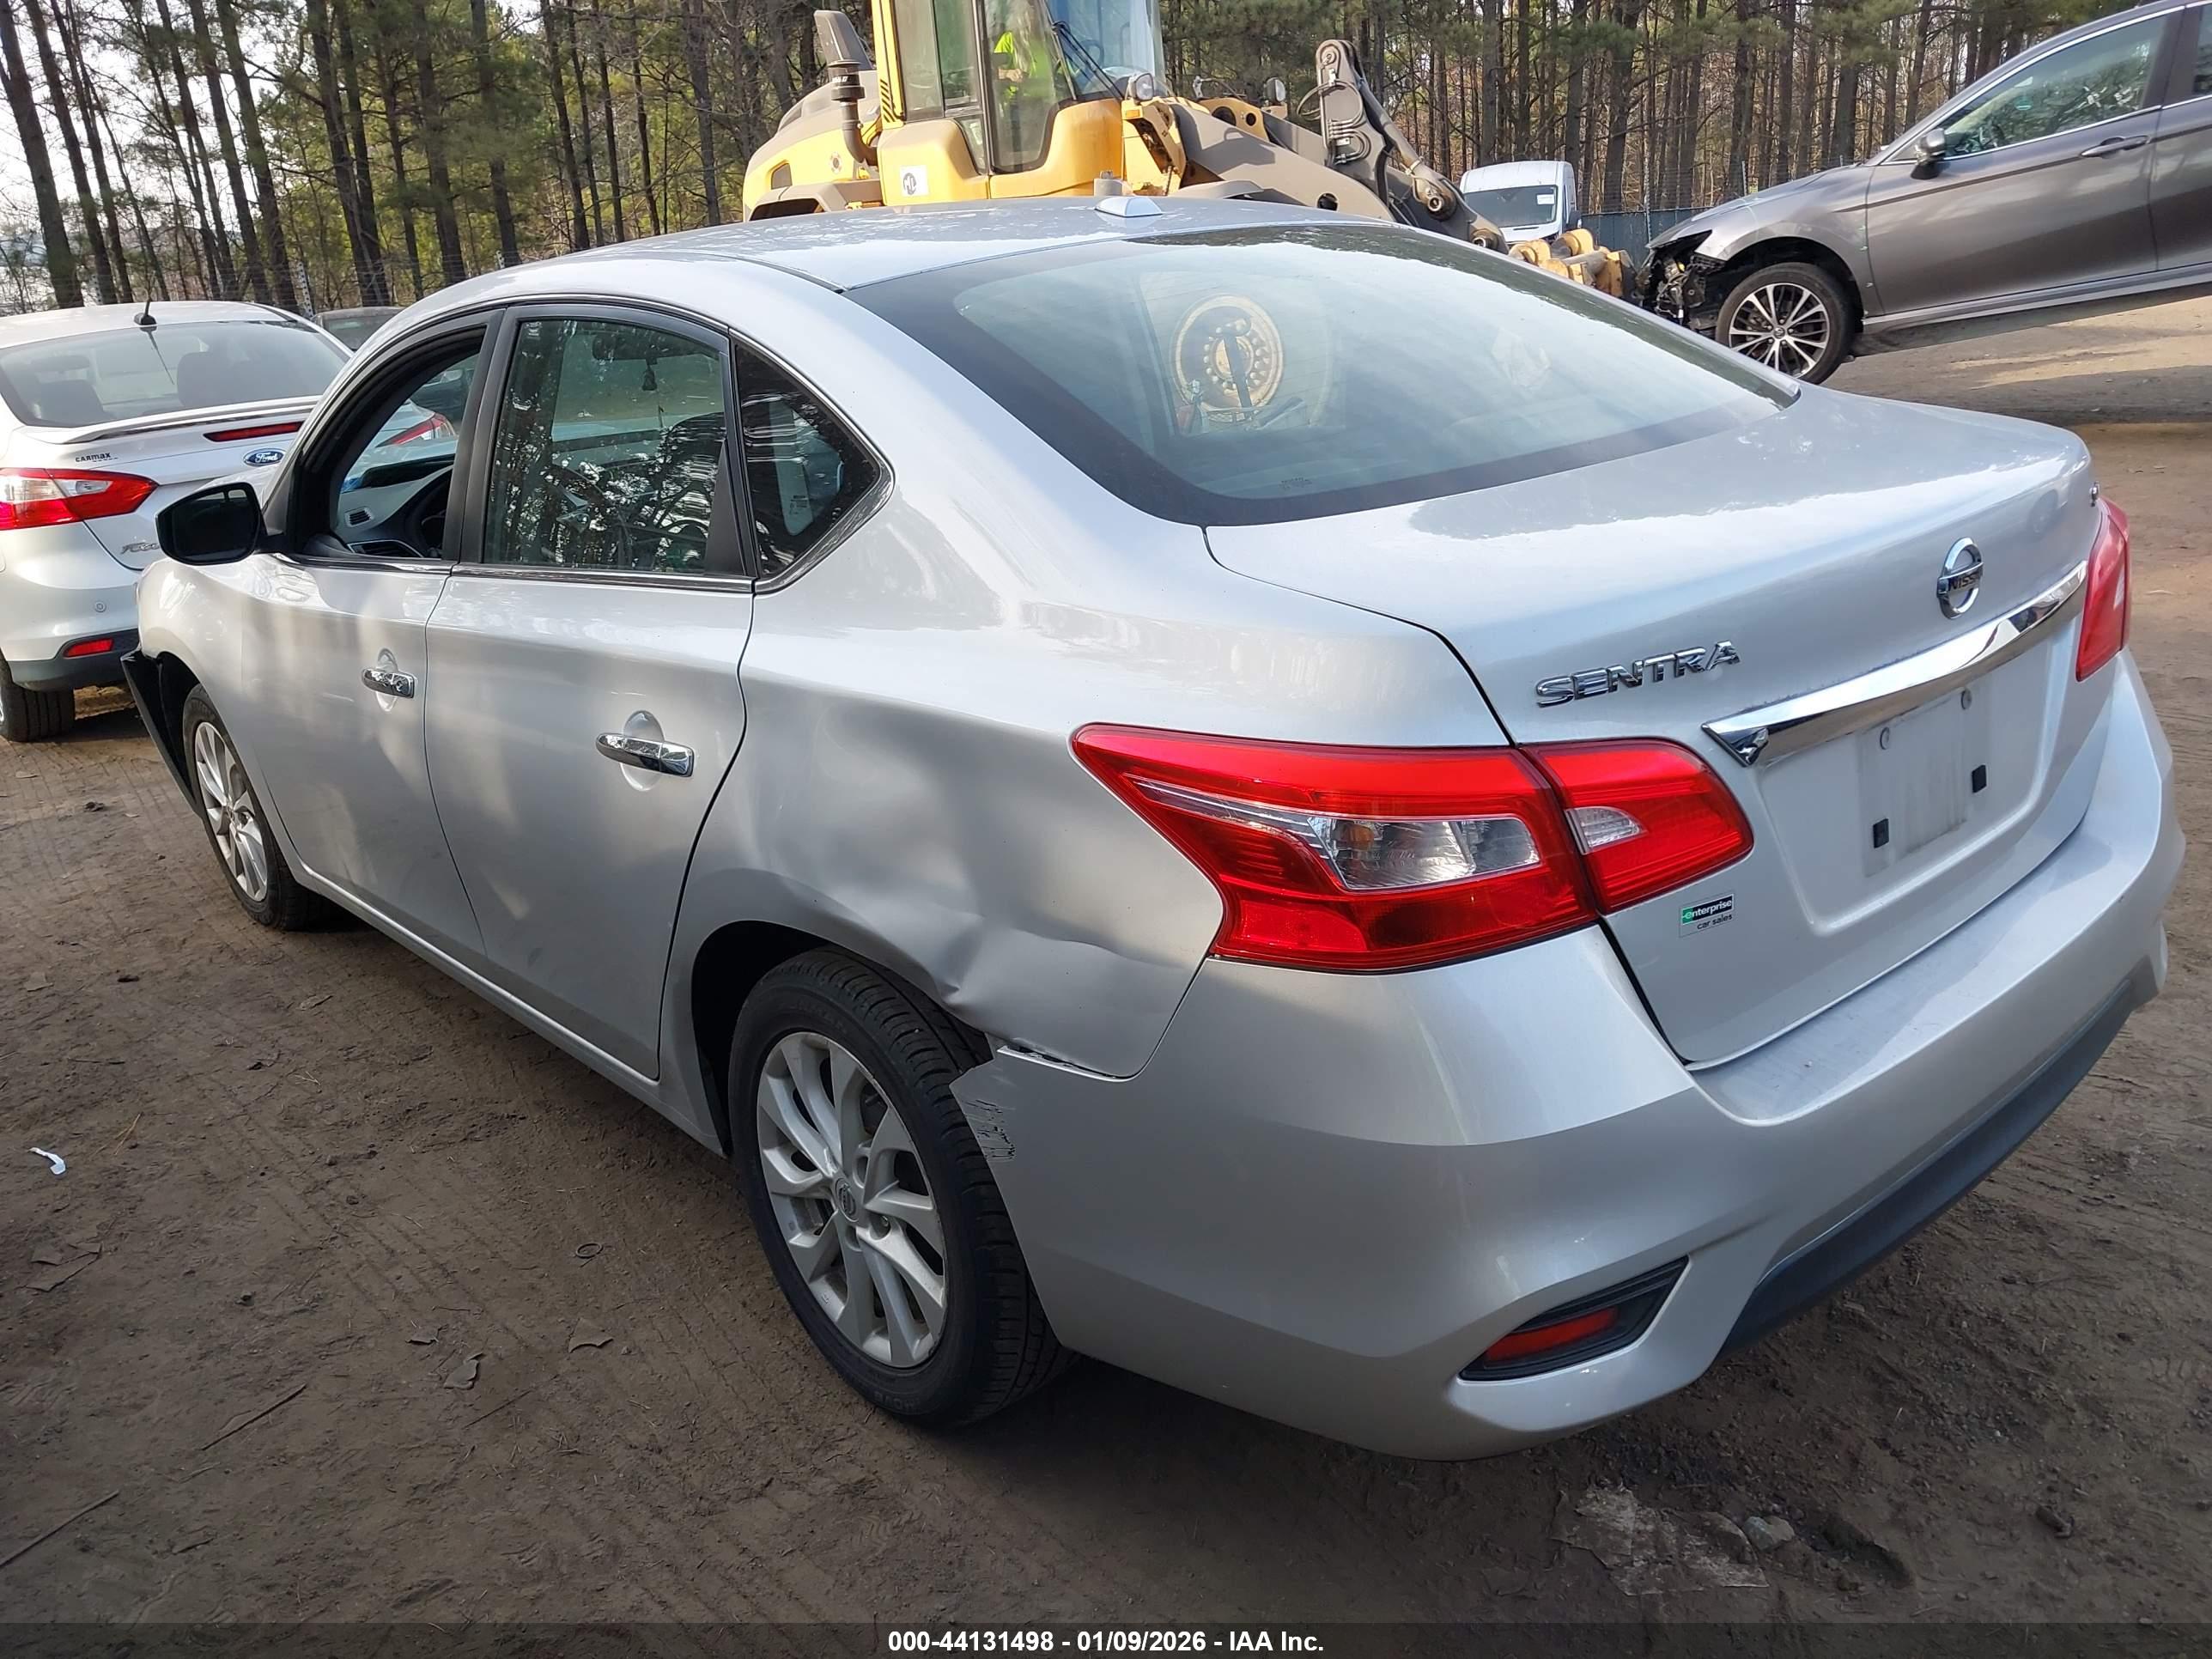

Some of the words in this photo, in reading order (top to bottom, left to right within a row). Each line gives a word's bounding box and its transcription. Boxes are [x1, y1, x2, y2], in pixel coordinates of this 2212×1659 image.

[1535, 641, 1741, 708] SENTRA
[1682, 900, 1732, 919] enterprise
[1697, 921, 1711, 930] car
[1712, 914, 1733, 926] sales
